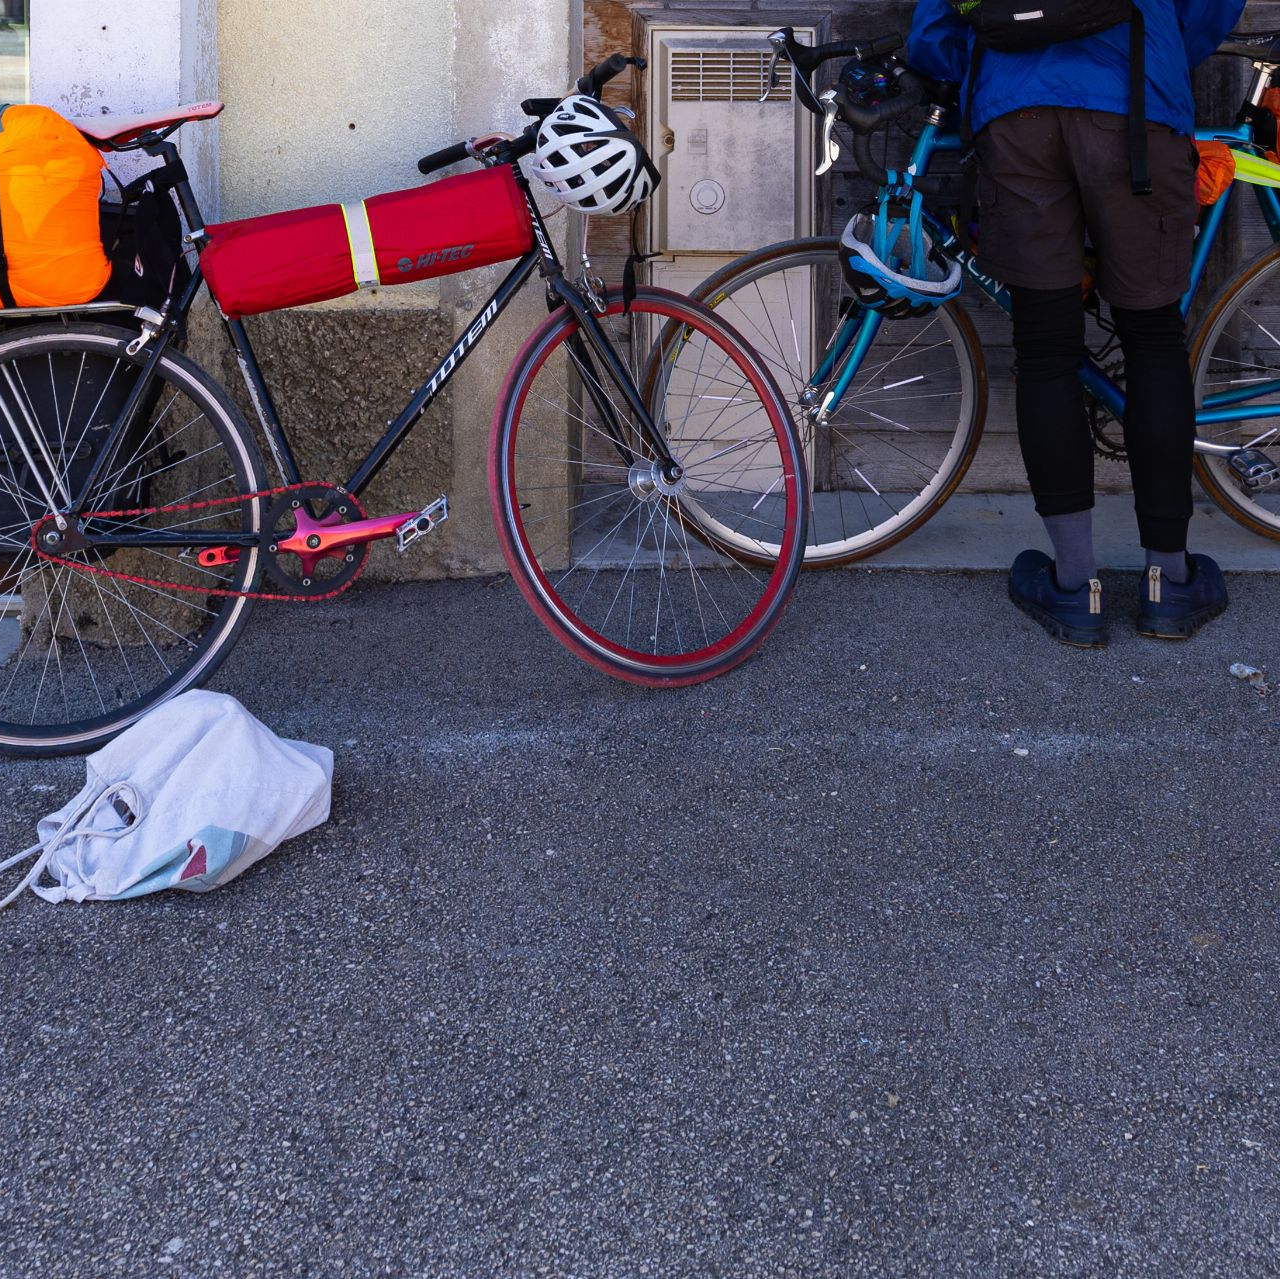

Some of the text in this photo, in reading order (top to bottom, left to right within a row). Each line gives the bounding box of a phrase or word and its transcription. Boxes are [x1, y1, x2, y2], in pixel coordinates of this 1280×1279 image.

[188, 102, 212, 112] TOTEM
[416, 243, 475, 270] HI-TEC
[426, 298, 498, 393] TOTEM
